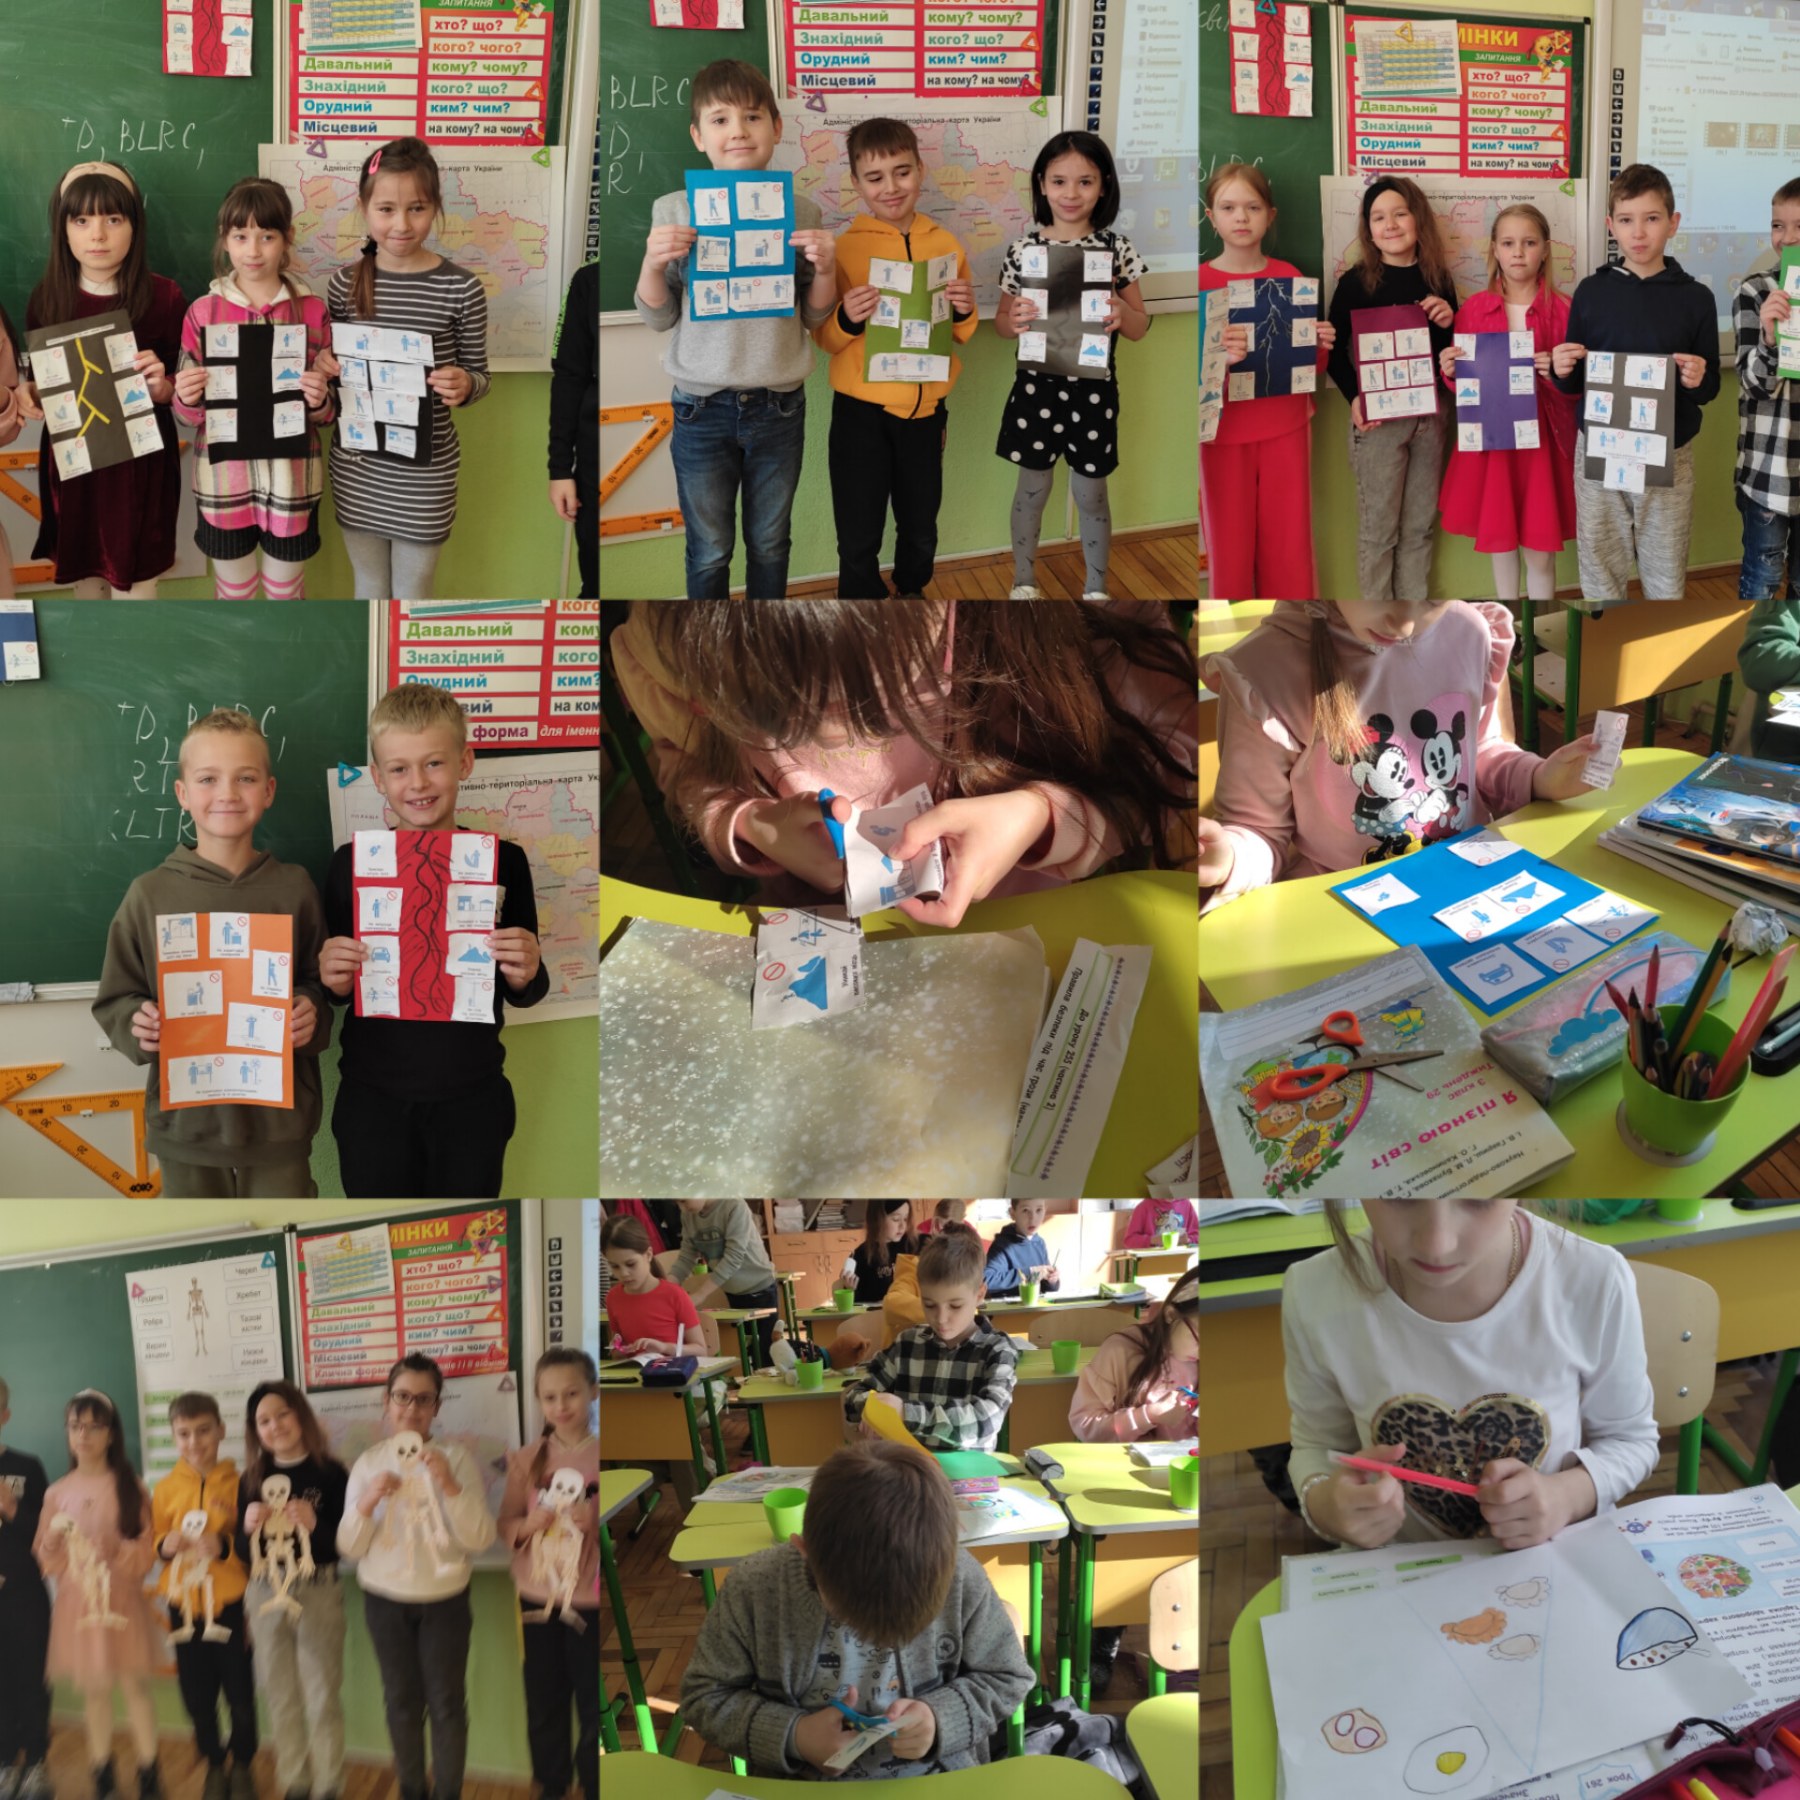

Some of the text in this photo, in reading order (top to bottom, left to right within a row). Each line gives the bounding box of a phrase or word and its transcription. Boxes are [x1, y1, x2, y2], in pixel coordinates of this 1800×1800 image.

[800, 9, 889, 23] Давальний
[928, 11, 1023, 26] кому? чому?
[435, 19, 503, 32] хто? що?
[800, 32, 883, 46] Знахідний
[928, 33, 1004, 47] кого? що?
[1460, 28, 1518, 47] МІНКИ
[433, 41, 522, 53] кого? чого?
[304, 57, 393, 71] Давальний
[801, 53, 870, 67] Орудний
[928, 53, 1007, 64] ким? чим?
[1475, 53, 1521, 62] ЗАПИТАННЯ
[432, 61, 528, 75] кому? чому?
[801, 75, 876, 87] Місцевий
[927, 76, 940, 85] на
[944, 74, 978, 87] кому?
[981, 76, 994, 85] на
[1473, 72, 1530, 84] хто? що?
[304, 80, 386, 94] Знахідний
[431, 83, 508, 95] кого? що?
[1472, 90, 1547, 100] кого? чого?
[304, 99, 372, 114] Орудний
[430, 102, 510, 113] ким? чим?
[1360, 101, 1438, 114] Давальний
[1472, 107, 1552, 119] кому? чому?
[304, 121, 377, 134] Місцевий
[428, 125, 442, 133] на
[446, 123, 480, 136] кому?
[483, 125, 497, 133] на
[1361, 120, 1433, 133] Знахідний
[1472, 125, 1536, 137] кого? що?
[1360, 137, 1421, 150] Орудний
[1472, 141, 1539, 151] ким? чим?
[1361, 156, 1426, 167] Місцевий
[1486, 159, 1514, 170] кому?
[562, 601, 600, 611] кого
[407, 621, 513, 639] Давальний
[560, 624, 600, 639] кому
[406, 649, 505, 666] Знахідний
[558, 651, 600, 663] кого
[554, 701, 600, 712] на ком
[472, 725, 600, 741] форма для іменн
[459, 777, 553, 791] тивно-територіальна
[558, 775, 583, 785] карта
[1023, 966, 1082, 1099] Правила безпеки під час грози
[1042, 1008, 1089, 1111] До уроку 255 (частина 2)
[26, 1073, 37, 1081] 50
[1426, 1061, 1491, 1099] Тиждень 29
[1448, 1082, 1474, 1100] клас
[62, 1104, 72, 1112] 10
[1369, 1089, 1517, 1171] Я пізнаю світ
[389, 1221, 449, 1242] МІНКИ
[408, 1244, 453, 1256] ЗАПИТАННЯ
[406, 1260, 463, 1275] хто? що?
[406, 1275, 480, 1292] кого? чого?
[407, 1291, 488, 1309] кому? чому?
[311, 1303, 375, 1318] Давальний
[407, 1309, 471, 1324] кого? що?
[313, 1320, 372, 1333] Знахідний
[408, 1324, 475, 1340] ким? чим?
[313, 1337, 363, 1349] Орудний
[452, 1345, 464, 1353] на
[313, 1352, 368, 1364] Місцевий
[314, 1368, 353, 1379] Клична
[1721, 1648, 1749, 1658] потріб
